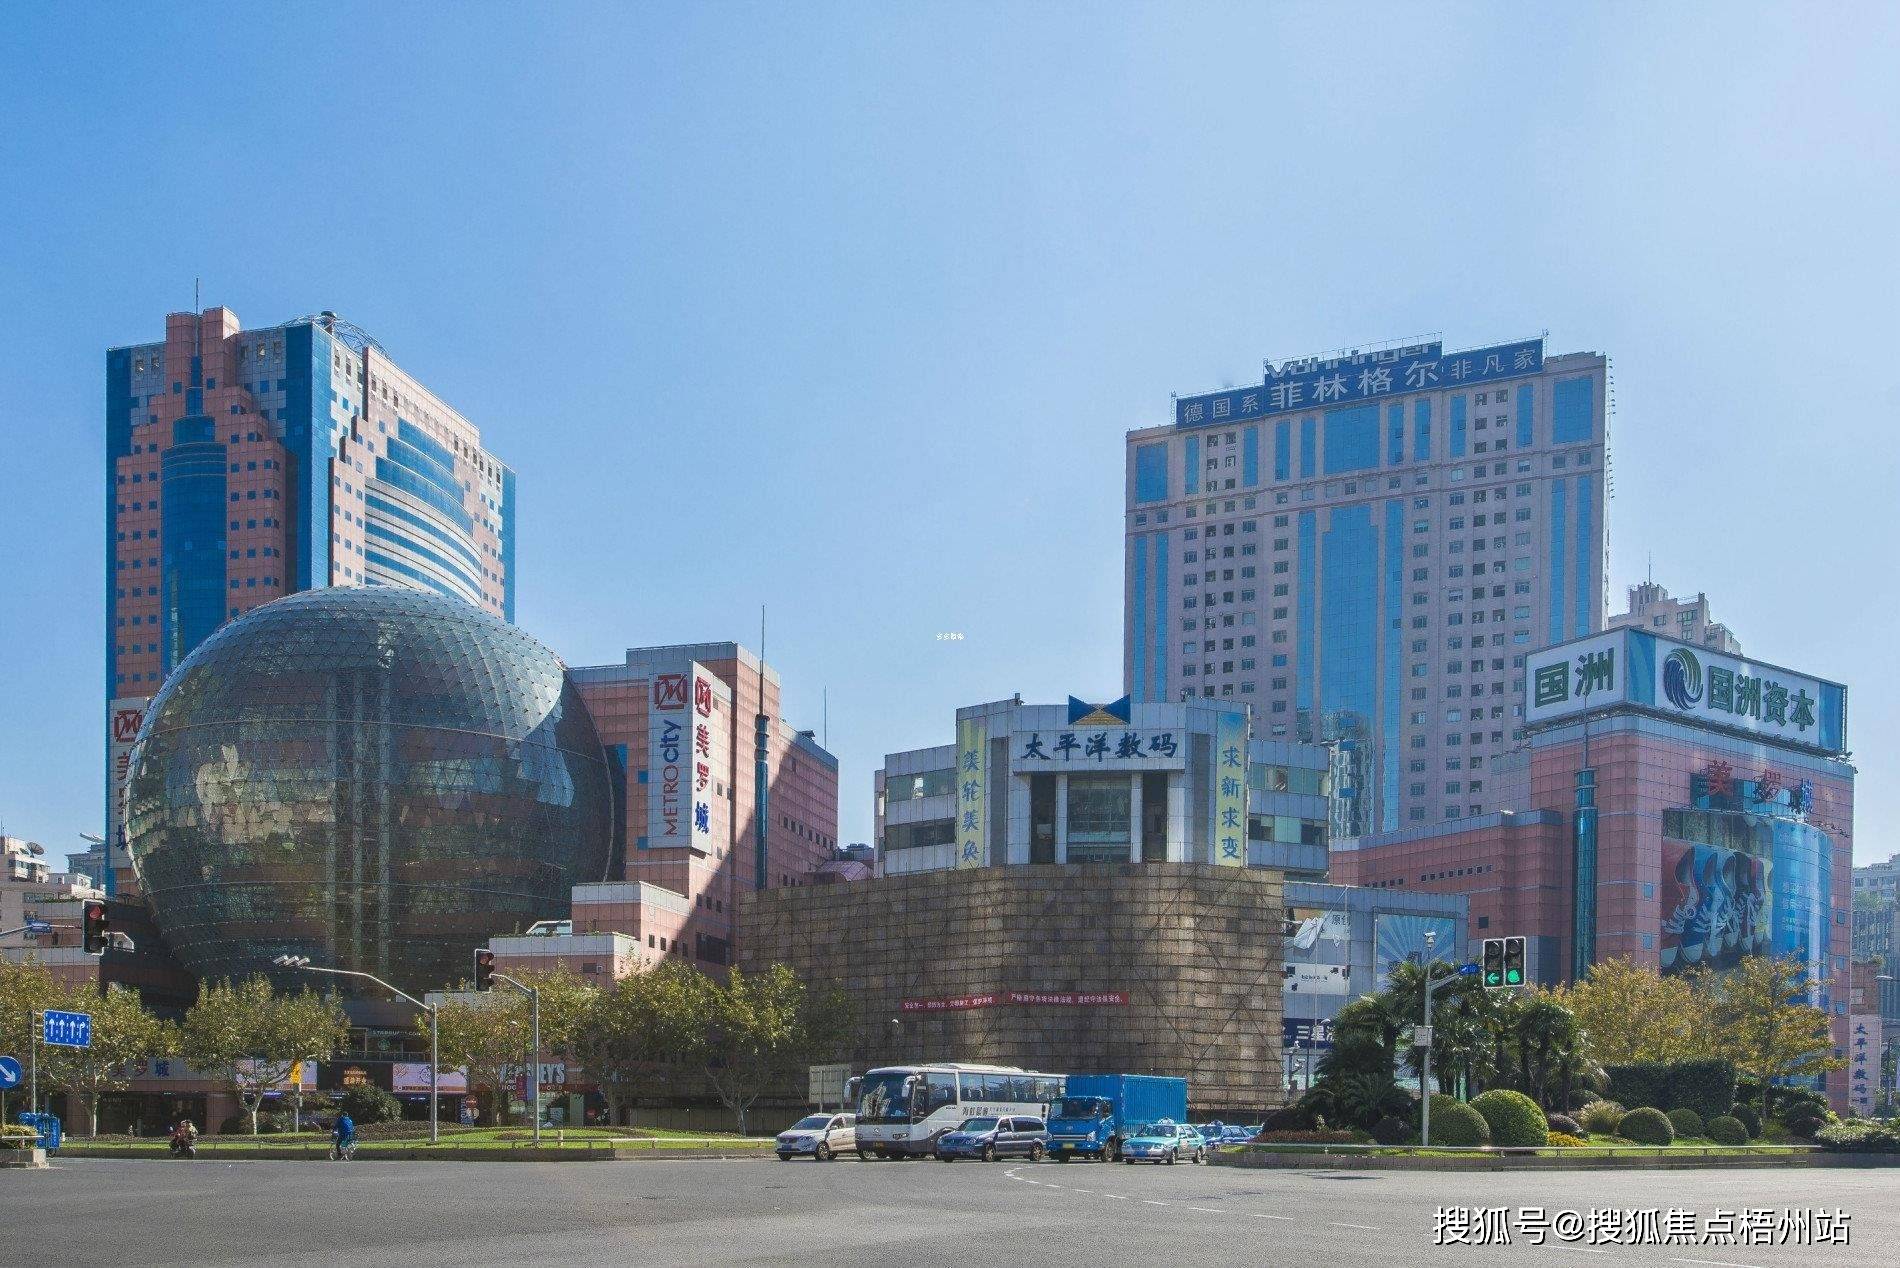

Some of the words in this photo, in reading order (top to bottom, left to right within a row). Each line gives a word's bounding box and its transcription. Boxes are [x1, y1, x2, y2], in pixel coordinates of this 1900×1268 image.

[1184, 393, 1260, 424] 德国系
[1269, 359, 1440, 409] 菲林格尔
[1451, 348, 1537, 380] 非凡家
[1535, 647, 1615, 709] 国洲
[1708, 665, 1816, 732] 国洲资本
[694, 723, 711, 835] 美罗城
[1020, 732, 1178, 763] 太平洋数码
[961, 748, 981, 861] 美轮美奂
[1221, 745, 1241, 859] 求新求变
